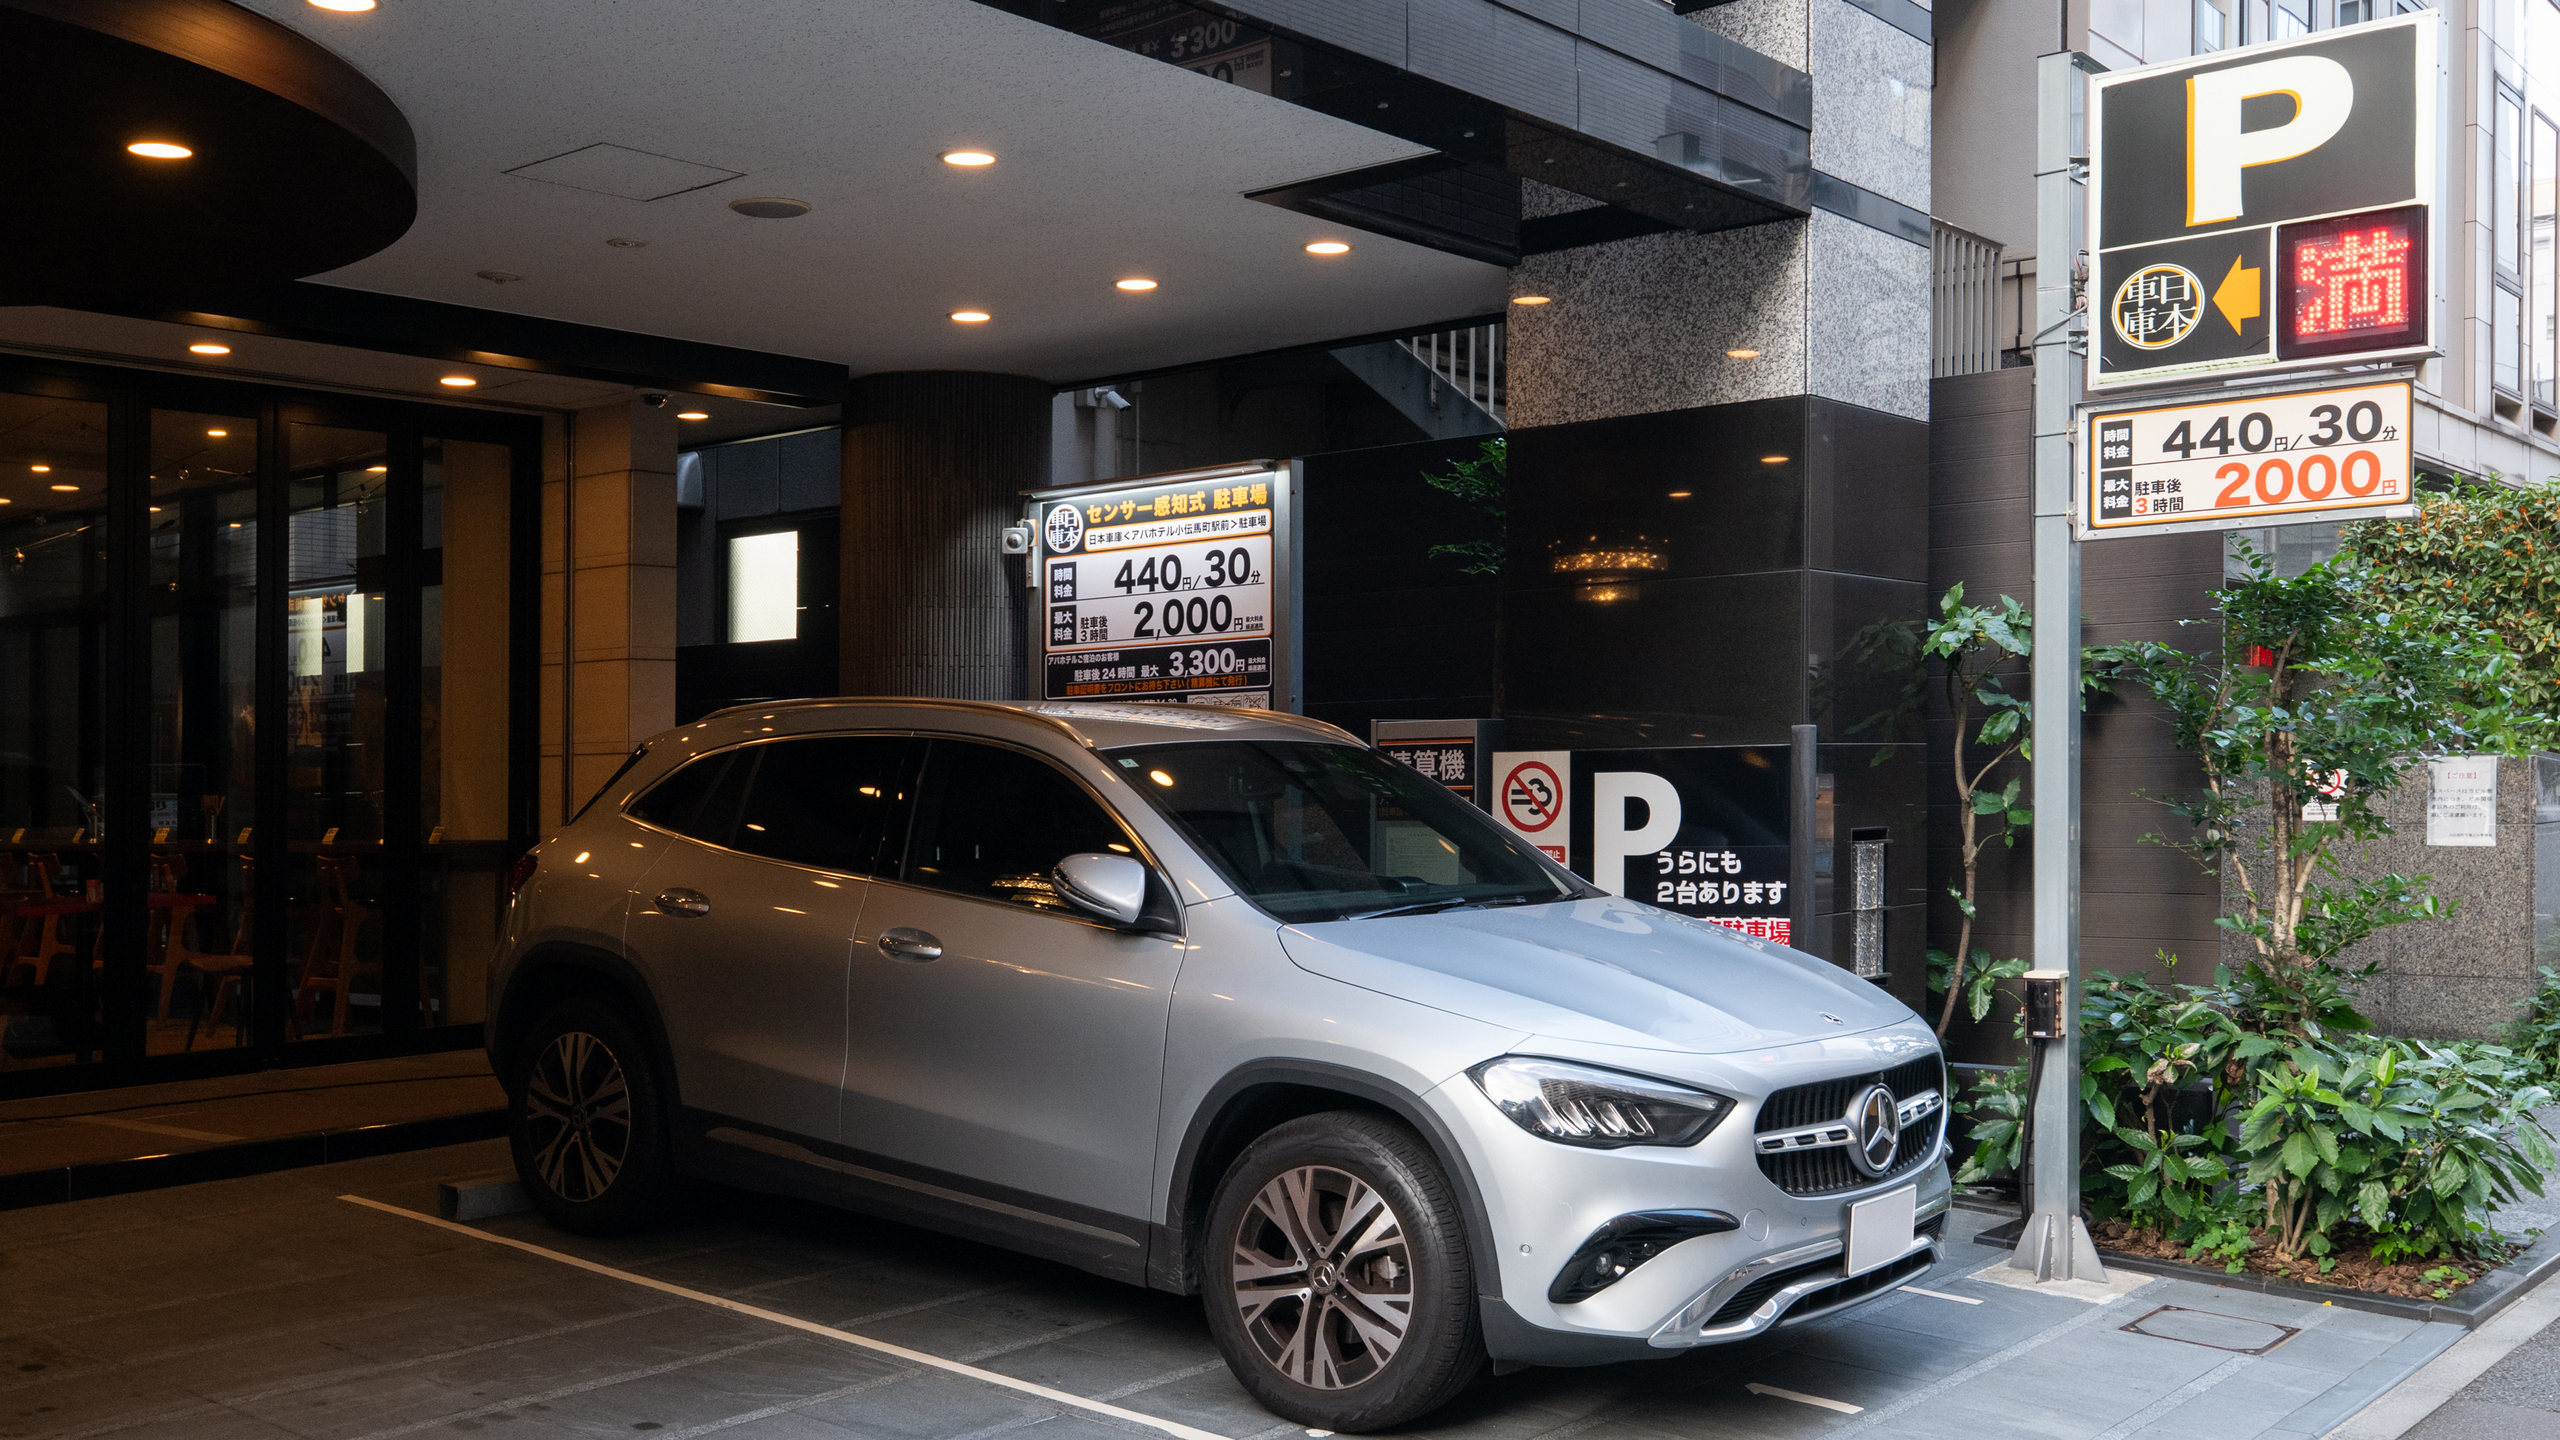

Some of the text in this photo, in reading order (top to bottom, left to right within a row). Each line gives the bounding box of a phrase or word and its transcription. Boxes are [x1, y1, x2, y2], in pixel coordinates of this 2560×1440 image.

[2187, 55, 2354, 226] P
[2299, 229, 2410, 335] 満
[2104, 428, 2129, 443] 時間
[2103, 444, 2129, 459] 料金
[2103, 478, 2129, 493] 最大
[2135, 478, 2182, 496] 駐車後
[1086, 483, 1267, 524] センサー感知式 駐車場
[2103, 494, 2129, 510] 料金
[1054, 567, 1073, 582] 時間
[1054, 584, 1073, 599] 料金
[1054, 610, 1073, 625] 最大
[1080, 615, 1108, 629] 駐車後
[1054, 626, 1073, 642] 料金
[1141, 665, 1159, 678] 最大
[1594, 771, 1681, 898] P
[1657, 850, 1742, 875] うらにも
[1657, 879, 1787, 905] 2台あります
